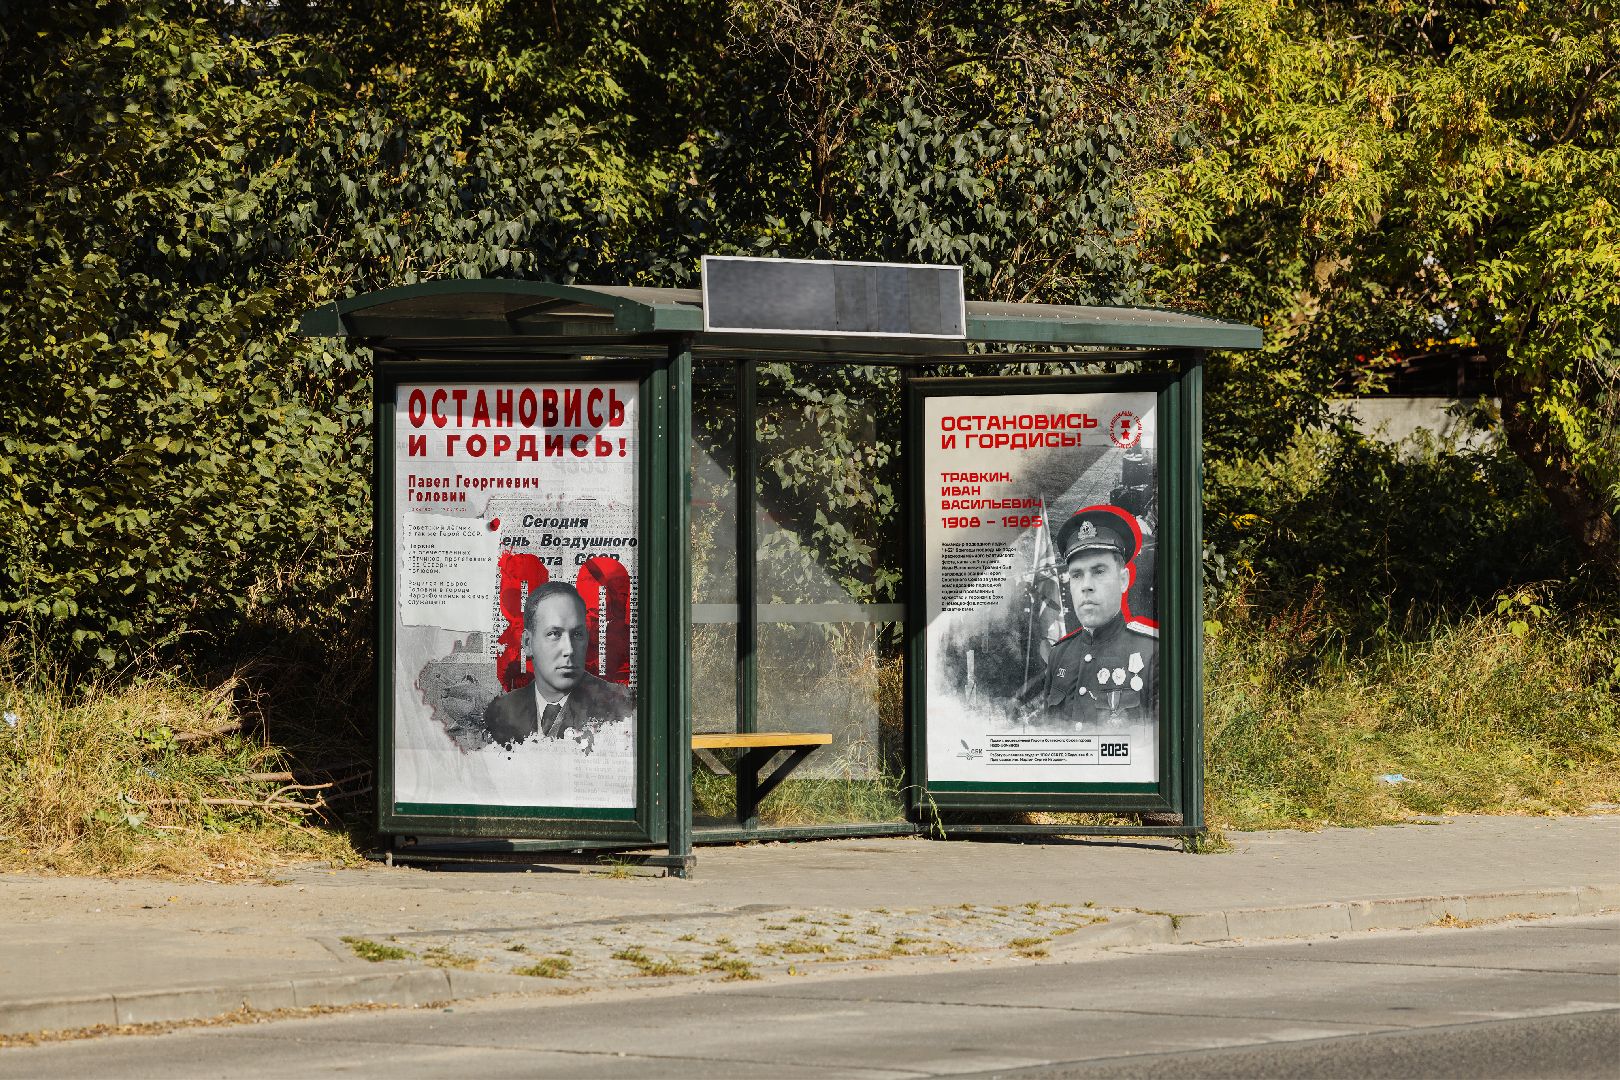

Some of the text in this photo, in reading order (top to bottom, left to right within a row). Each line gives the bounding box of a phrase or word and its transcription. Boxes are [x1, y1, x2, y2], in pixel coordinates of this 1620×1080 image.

[408, 387, 625, 429] ОСТАНОВИСЬ
[941, 413, 1098, 432] ОСТАНОВИСЬ
[408, 433, 627, 461] И ГОРДИСЬ!
[941, 433, 1082, 451] И ГОРДИСЬ!
[408, 475, 539, 490] Павел Георгиевич
[941, 471, 1013, 484] ТРАВКИН,
[408, 489, 466, 502] Головин
[941, 485, 981, 497] ИВАН
[941, 499, 1043, 511] ВАСИЛЬЕВИЧ
[523, 515, 588, 530] Сегодня
[941, 516, 981, 530] 1908
[1002, 515, 1043, 529] 1985
[500, 533, 638, 551] ень Воздушного
[1100, 743, 1129, 757] 2025
